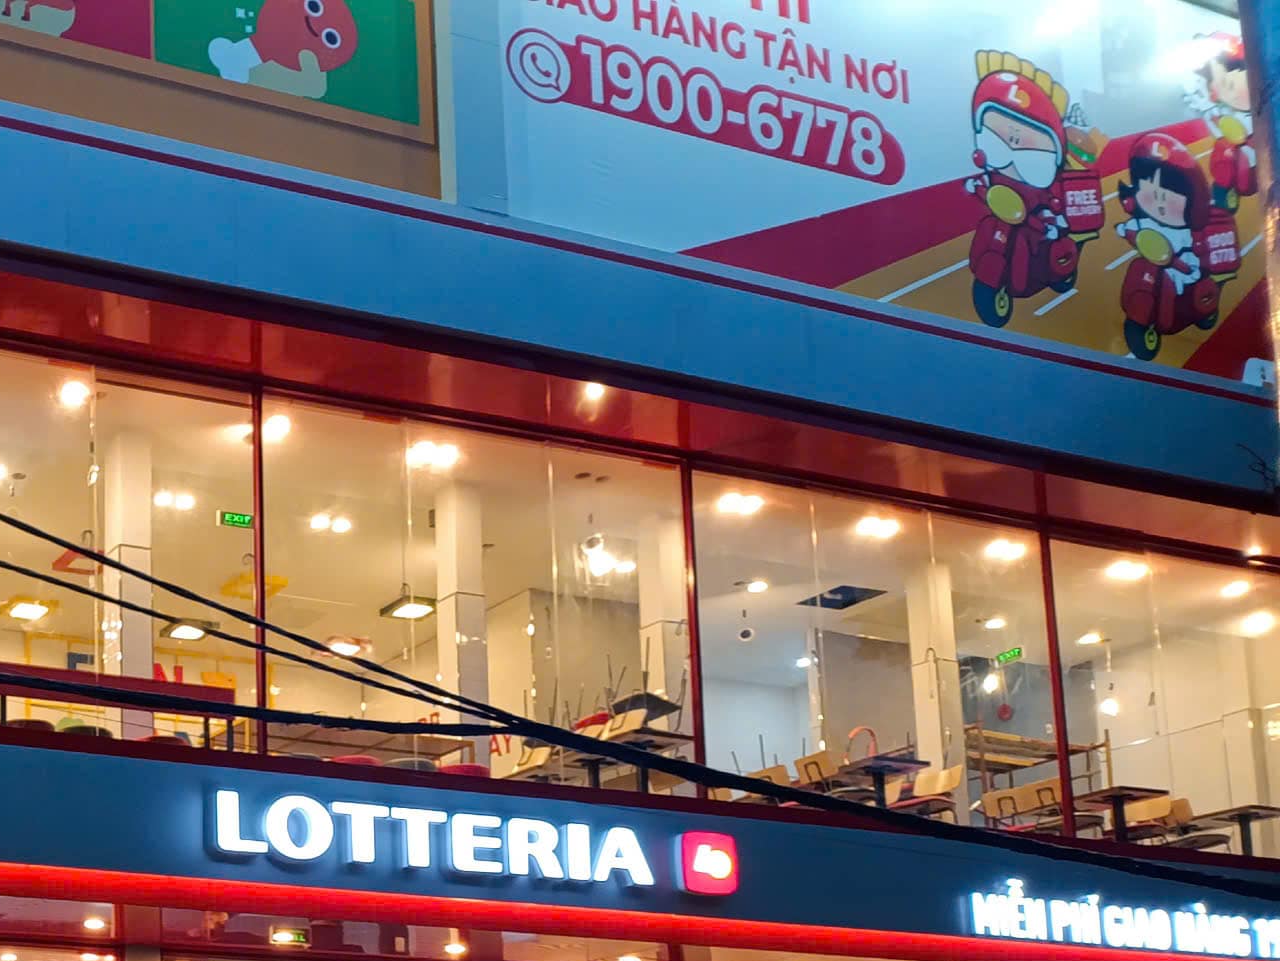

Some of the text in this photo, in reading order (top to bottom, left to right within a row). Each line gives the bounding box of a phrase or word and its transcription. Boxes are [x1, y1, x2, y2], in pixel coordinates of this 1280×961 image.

[531, 0, 618, 22] AO
[754, 29, 832, 84] TẬN
[844, 54, 910, 103] NƠI
[580, 40, 886, 176] 1900-6778
[1066, 189, 1098, 205] FREE
[224, 513, 251, 524] EXIT
[215, 789, 655, 887] LOTTERIA
[1254, 918, 1280, 958] T
